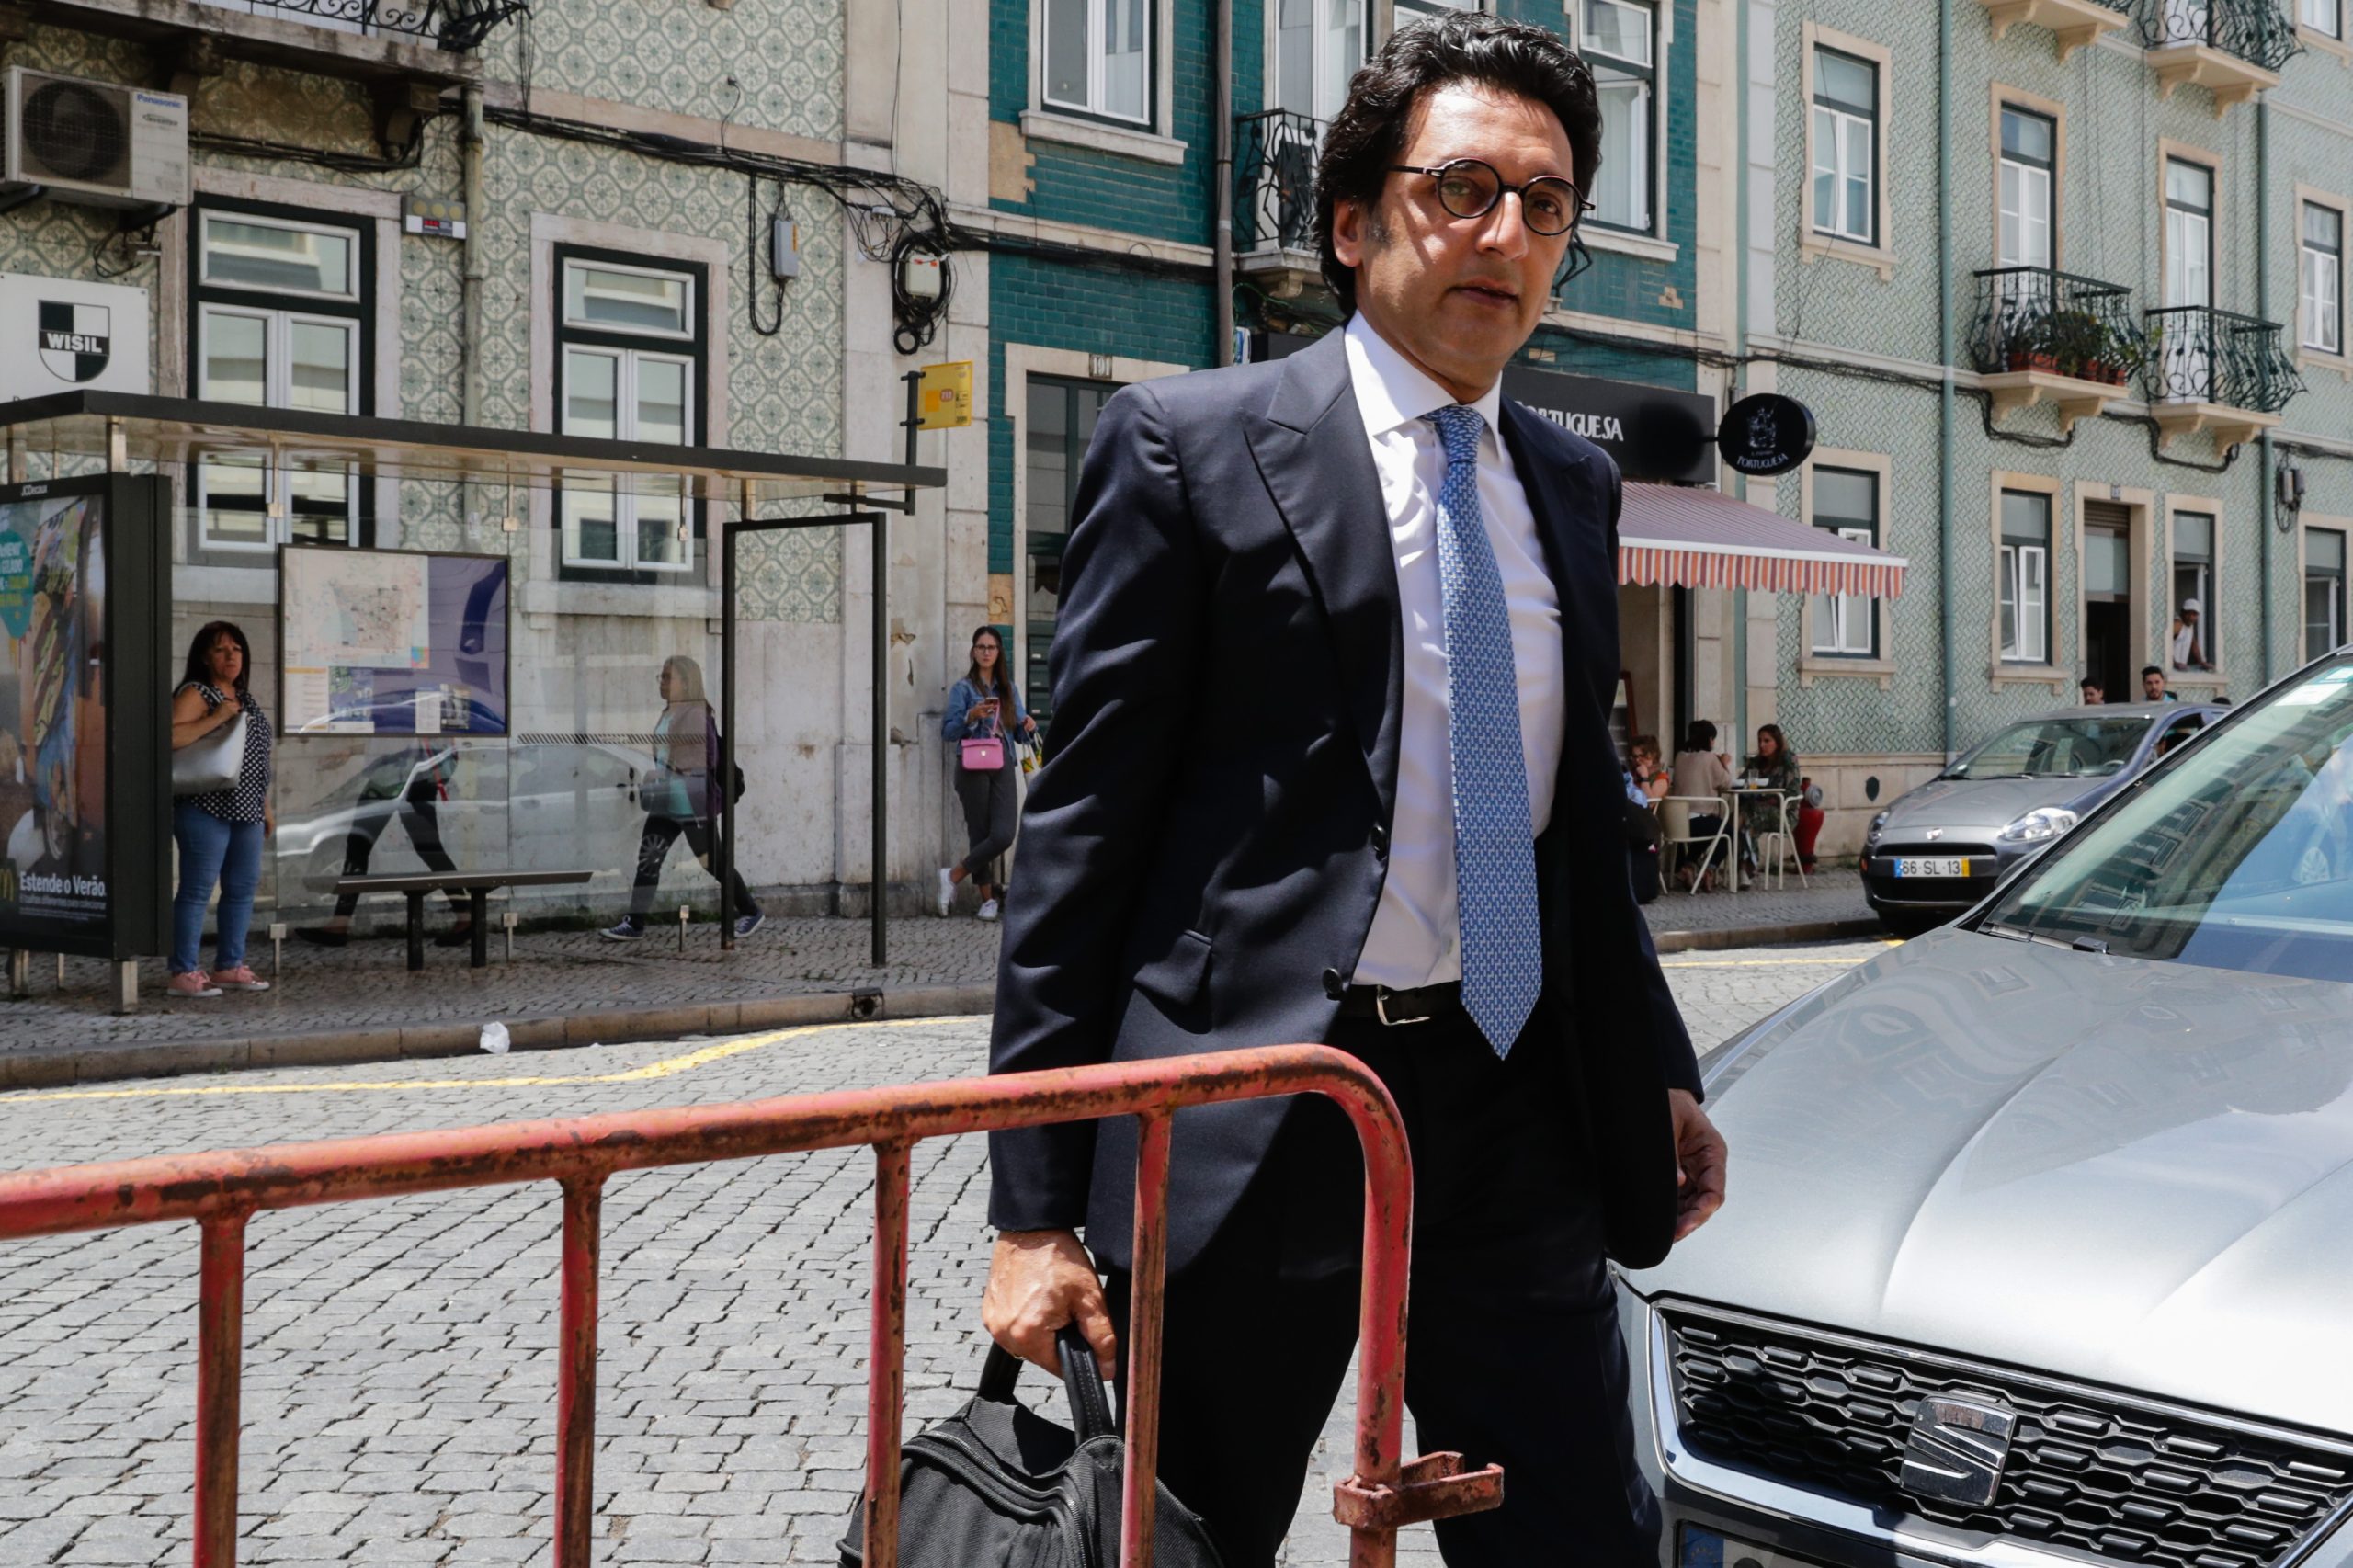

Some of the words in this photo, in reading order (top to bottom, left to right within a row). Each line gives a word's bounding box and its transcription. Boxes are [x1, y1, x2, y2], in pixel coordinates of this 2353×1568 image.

[136, 93, 182, 108] Panasonic
[47, 333, 102, 354] WISIL
[1093, 357, 1110, 376] 191
[19, 870, 63, 893] Estende
[64, 880, 72, 894] o
